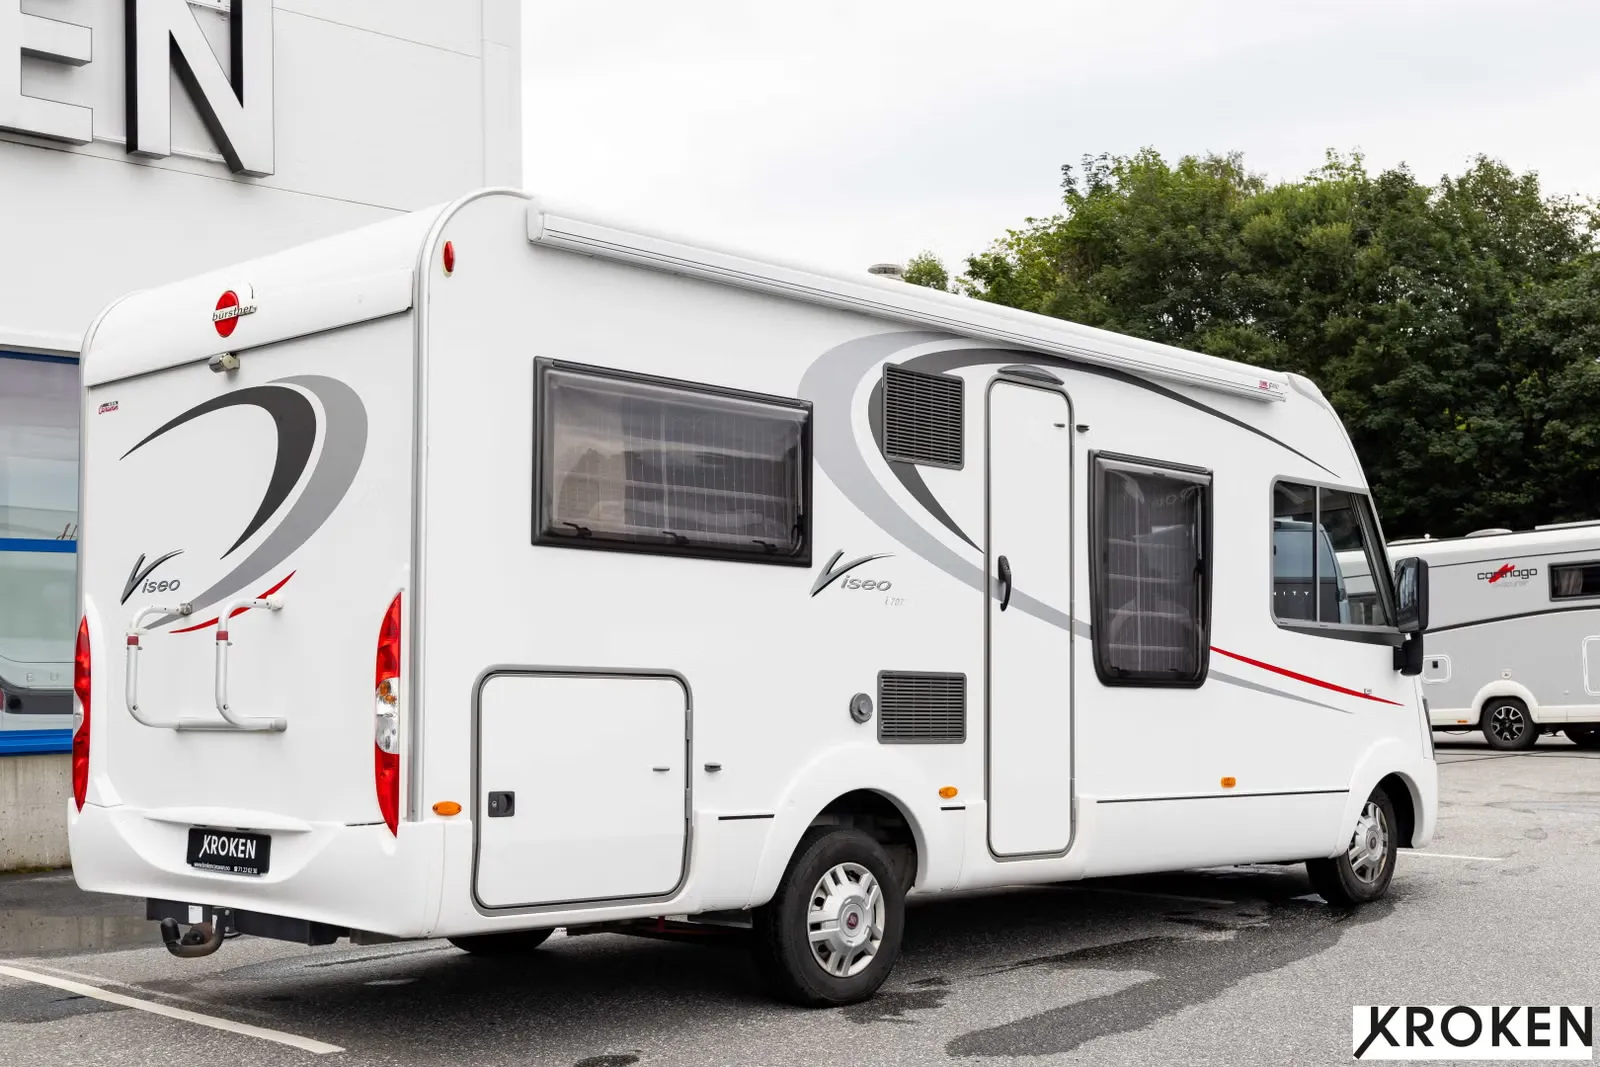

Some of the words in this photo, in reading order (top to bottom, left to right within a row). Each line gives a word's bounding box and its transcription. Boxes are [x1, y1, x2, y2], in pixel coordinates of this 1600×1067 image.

[212, 305, 254, 322] bürstner
[120, 549, 185, 605] Viseo
[809, 549, 896, 598] Viseo
[199, 834, 257, 860] KROKEN
